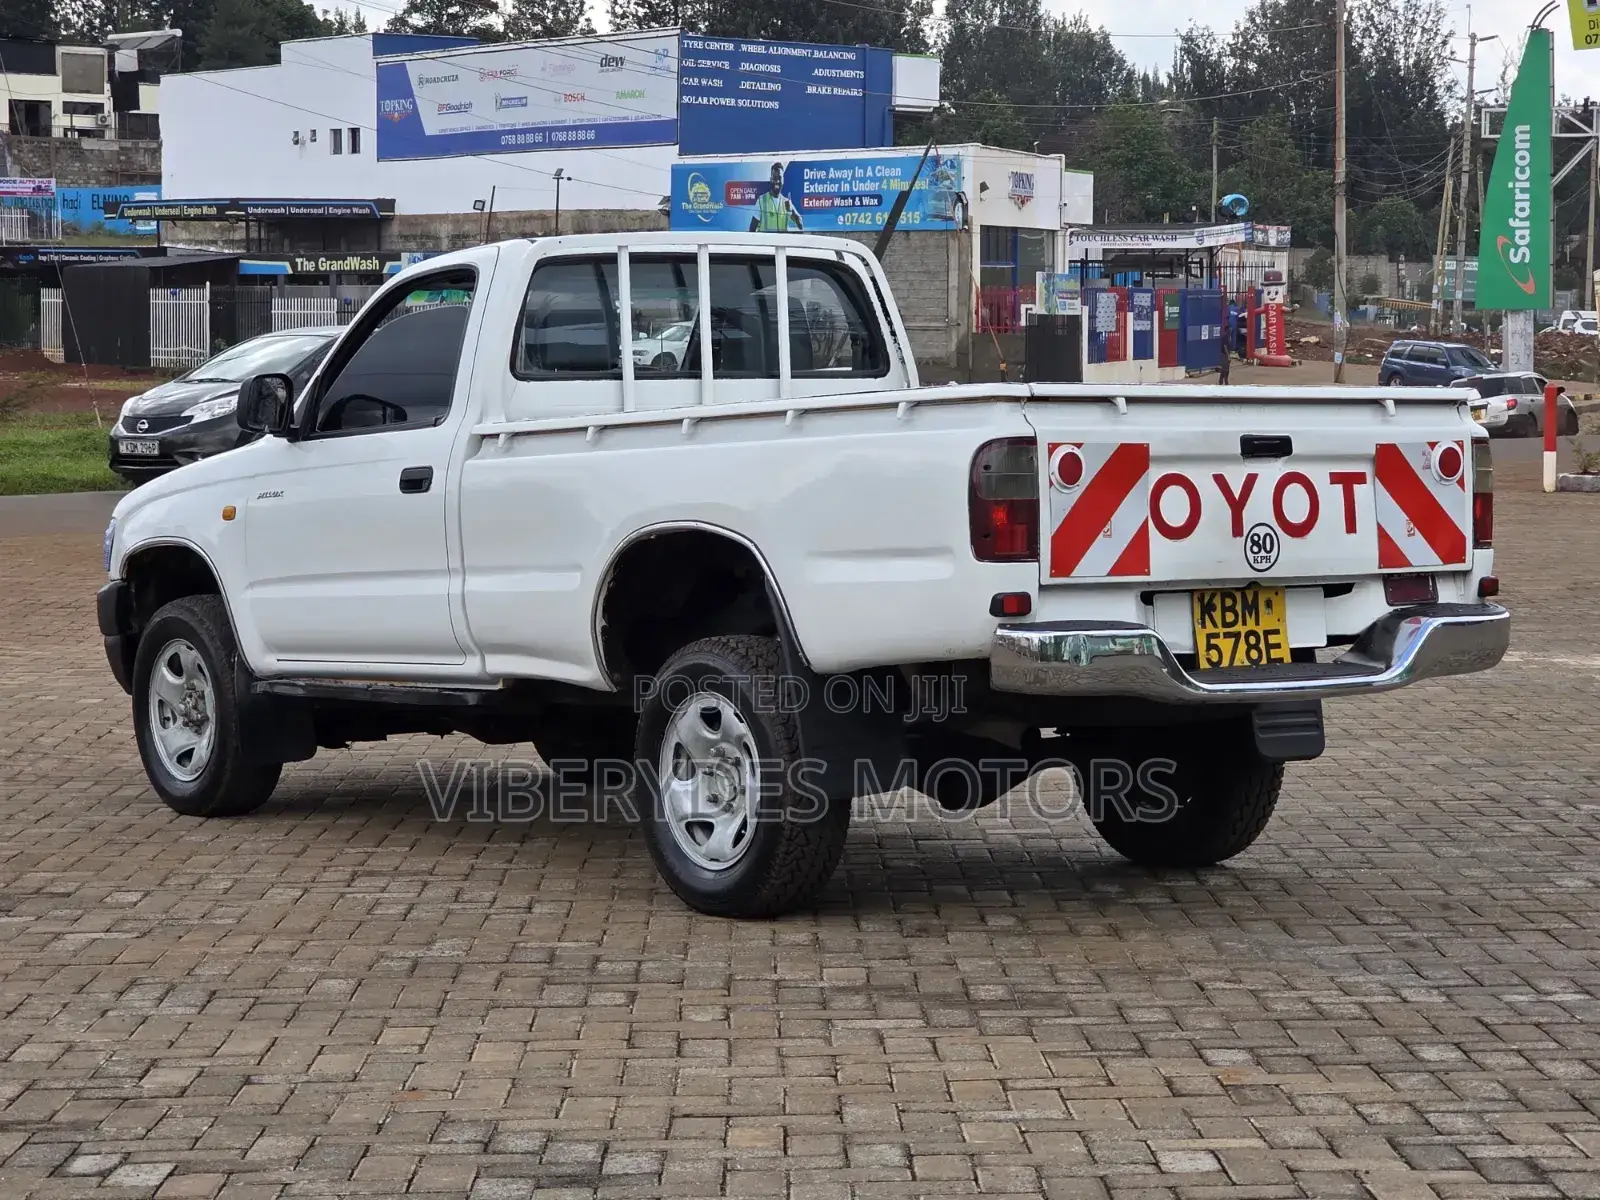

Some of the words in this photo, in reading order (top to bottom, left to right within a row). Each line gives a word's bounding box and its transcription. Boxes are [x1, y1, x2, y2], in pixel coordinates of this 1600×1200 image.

[705, 42, 734, 51] CENTER
[768, 46, 812, 57] ALIGNMENT
[698, 60, 730, 69] SERVICE
[701, 78, 723, 87] WASH
[833, 88, 863, 97] REPAIRS
[380, 98, 413, 111] TOPKING
[564, 93, 585, 102] BOSCH
[709, 97, 736, 107] POWER
[737, 98, 779, 110] SOLUTIONS
[804, 168, 826, 180] Drive
[828, 167, 853, 181] Away
[855, 166, 864, 177] In
[866, 166, 873, 177] A
[875, 165, 902, 177] Clean
[804, 182, 839, 193] Exterior
[841, 181, 850, 192] In
[852, 180, 880, 192] Under
[881, 179, 888, 190] 4
[1508, 124, 1531, 264] Safaricom
[804, 198, 833, 207] Exterior
[833, 197, 853, 207] Wash
[855, 197, 860, 206] &
[862, 196, 879, 206] Wax
[124, 206, 151, 217] Underwash
[155, 205, 180, 216] Underseal
[184, 206, 202, 217] Engine
[202, 205, 217, 215] Wash
[329, 207, 351, 215] Engine
[845, 213, 872, 225] 0742
[1075, 234, 1129, 242] TOUCHLESS
[1131, 234, 1151, 242] CAR
[1151, 234, 1177, 242] WASH
[296, 258, 315, 271] The
[318, 256, 380, 271] GrandWash
[1268, 304, 1277, 324] CAR
[1268, 326, 1277, 356] WASH
[1249, 533, 1275, 556] 80
[1252, 555, 1272, 565] KPH
[1198, 590, 1261, 630] KBM
[1205, 629, 1285, 667] 578E
